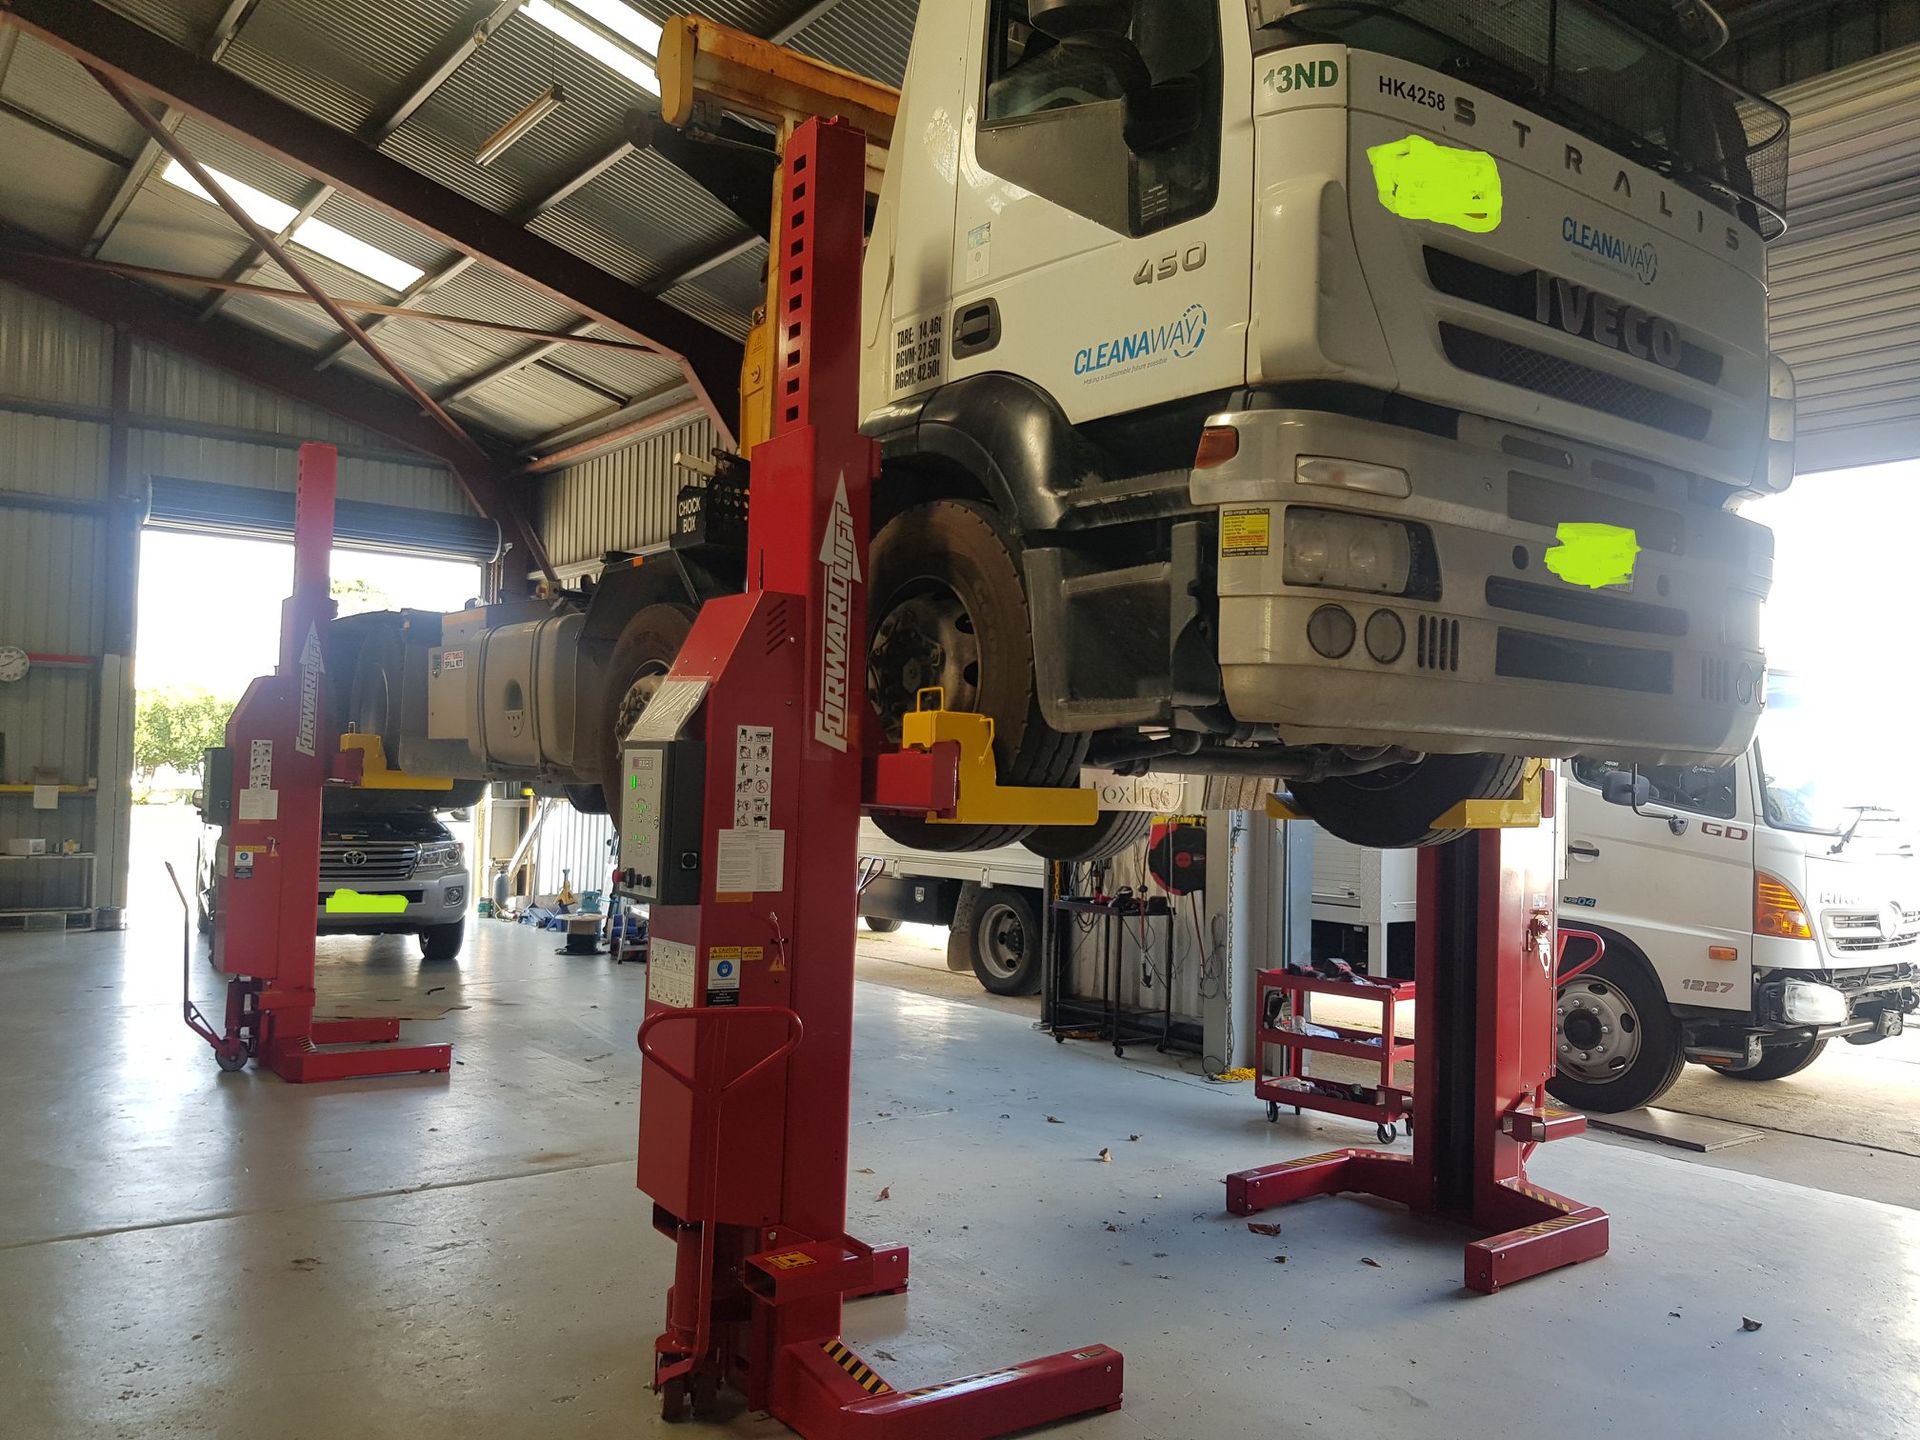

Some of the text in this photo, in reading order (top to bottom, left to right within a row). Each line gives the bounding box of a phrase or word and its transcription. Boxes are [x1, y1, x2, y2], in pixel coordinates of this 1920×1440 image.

[1264, 60, 1339, 97] 13ND
[1379, 75, 1445, 111] HK4258
[1454, 96, 1739, 251] STRALIS
[1133, 241, 1206, 285] 450
[1562, 216, 1656, 274] CLEANAWAY
[1536, 269, 1682, 369] IVECO
[1074, 314, 1200, 375] CLEANAWAY
[679, 496, 700, 517] CHOCK
[683, 515, 696, 534] BOX
[1701, 822, 1748, 841] GD
[1682, 978, 1735, 994] 1227
